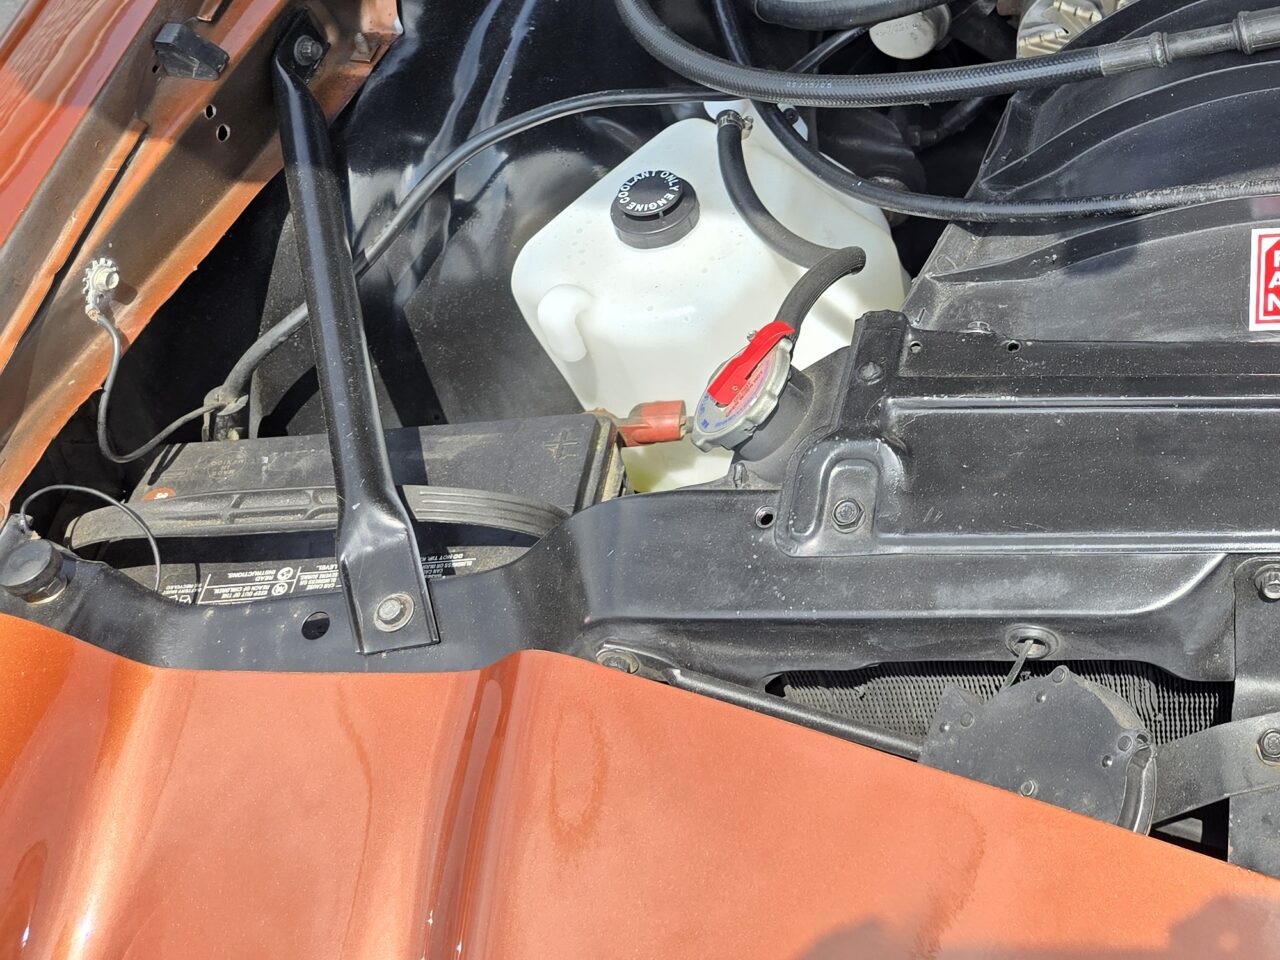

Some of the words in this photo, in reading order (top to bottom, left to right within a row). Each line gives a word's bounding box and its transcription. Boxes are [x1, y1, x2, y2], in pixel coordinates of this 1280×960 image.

[618, 170, 656, 204] COOLANT
[660, 170, 680, 192] ONLY
[626, 193, 675, 212] ENGINE
[227, 569, 277, 578] INSTRUCTIONS.
